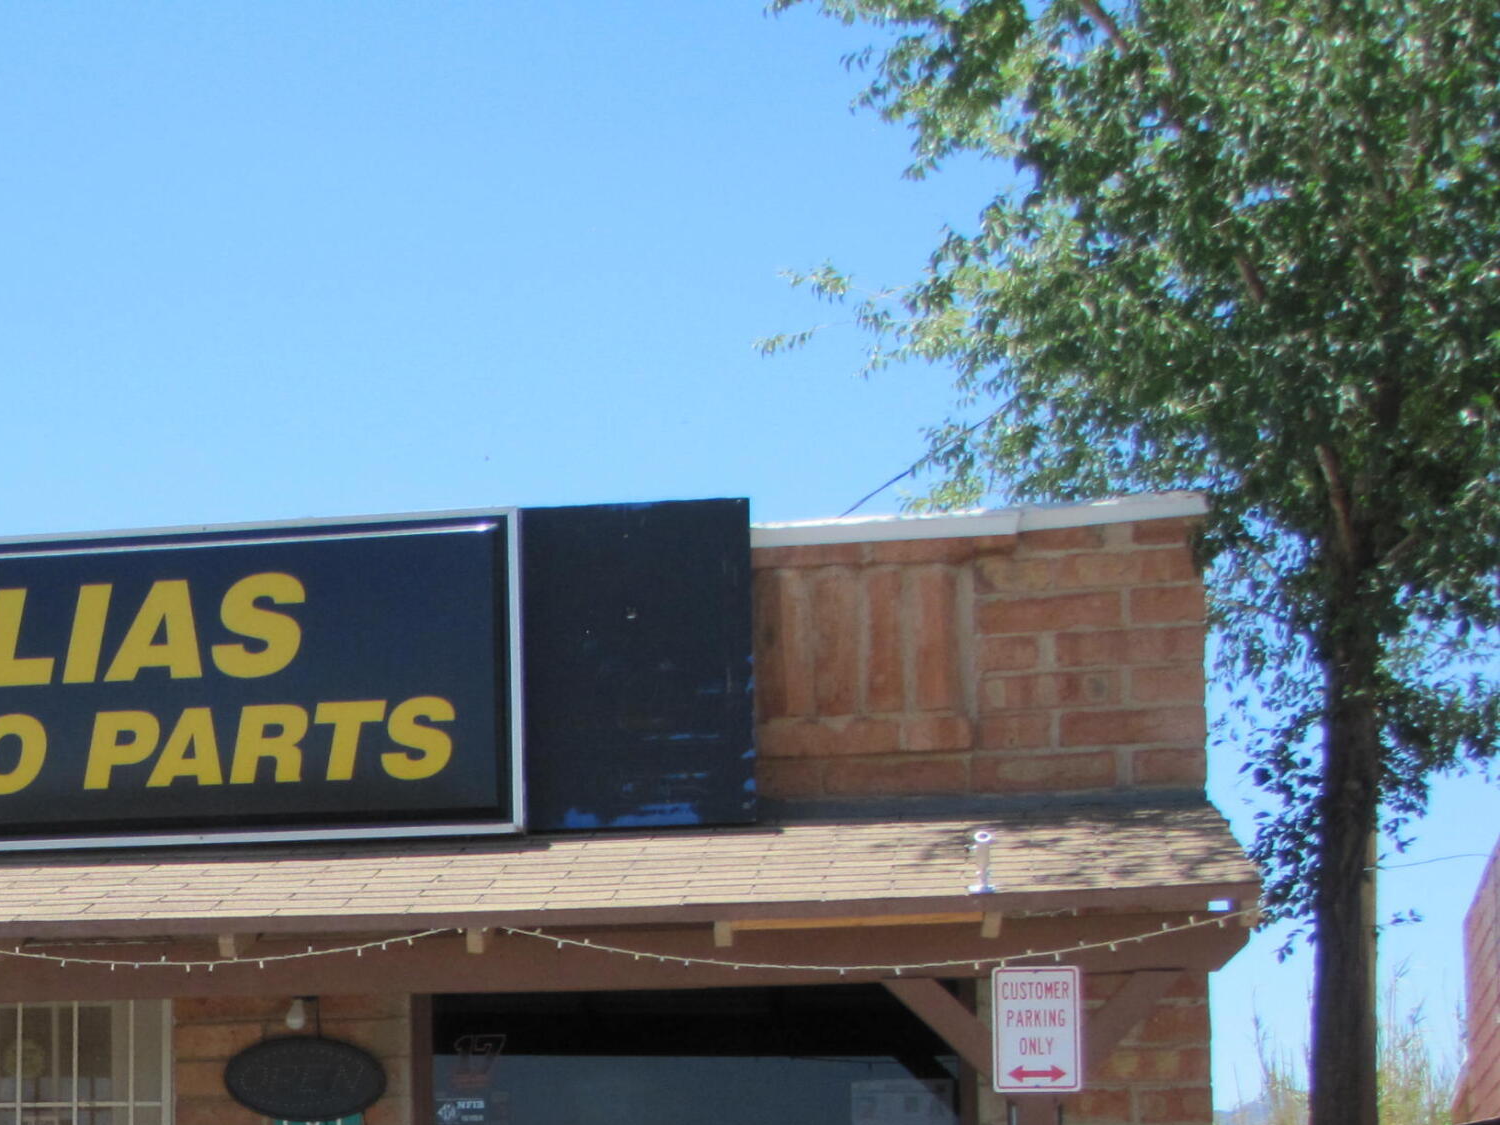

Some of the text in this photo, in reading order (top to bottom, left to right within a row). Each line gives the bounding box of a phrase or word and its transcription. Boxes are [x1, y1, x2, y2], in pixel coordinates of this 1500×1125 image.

[84, 695, 455, 790] PARTS
[1001, 981, 1069, 1000] CUSTOMER
[1006, 1009, 1066, 1028] PARKING
[1019, 1037, 1054, 1056] ONLY
